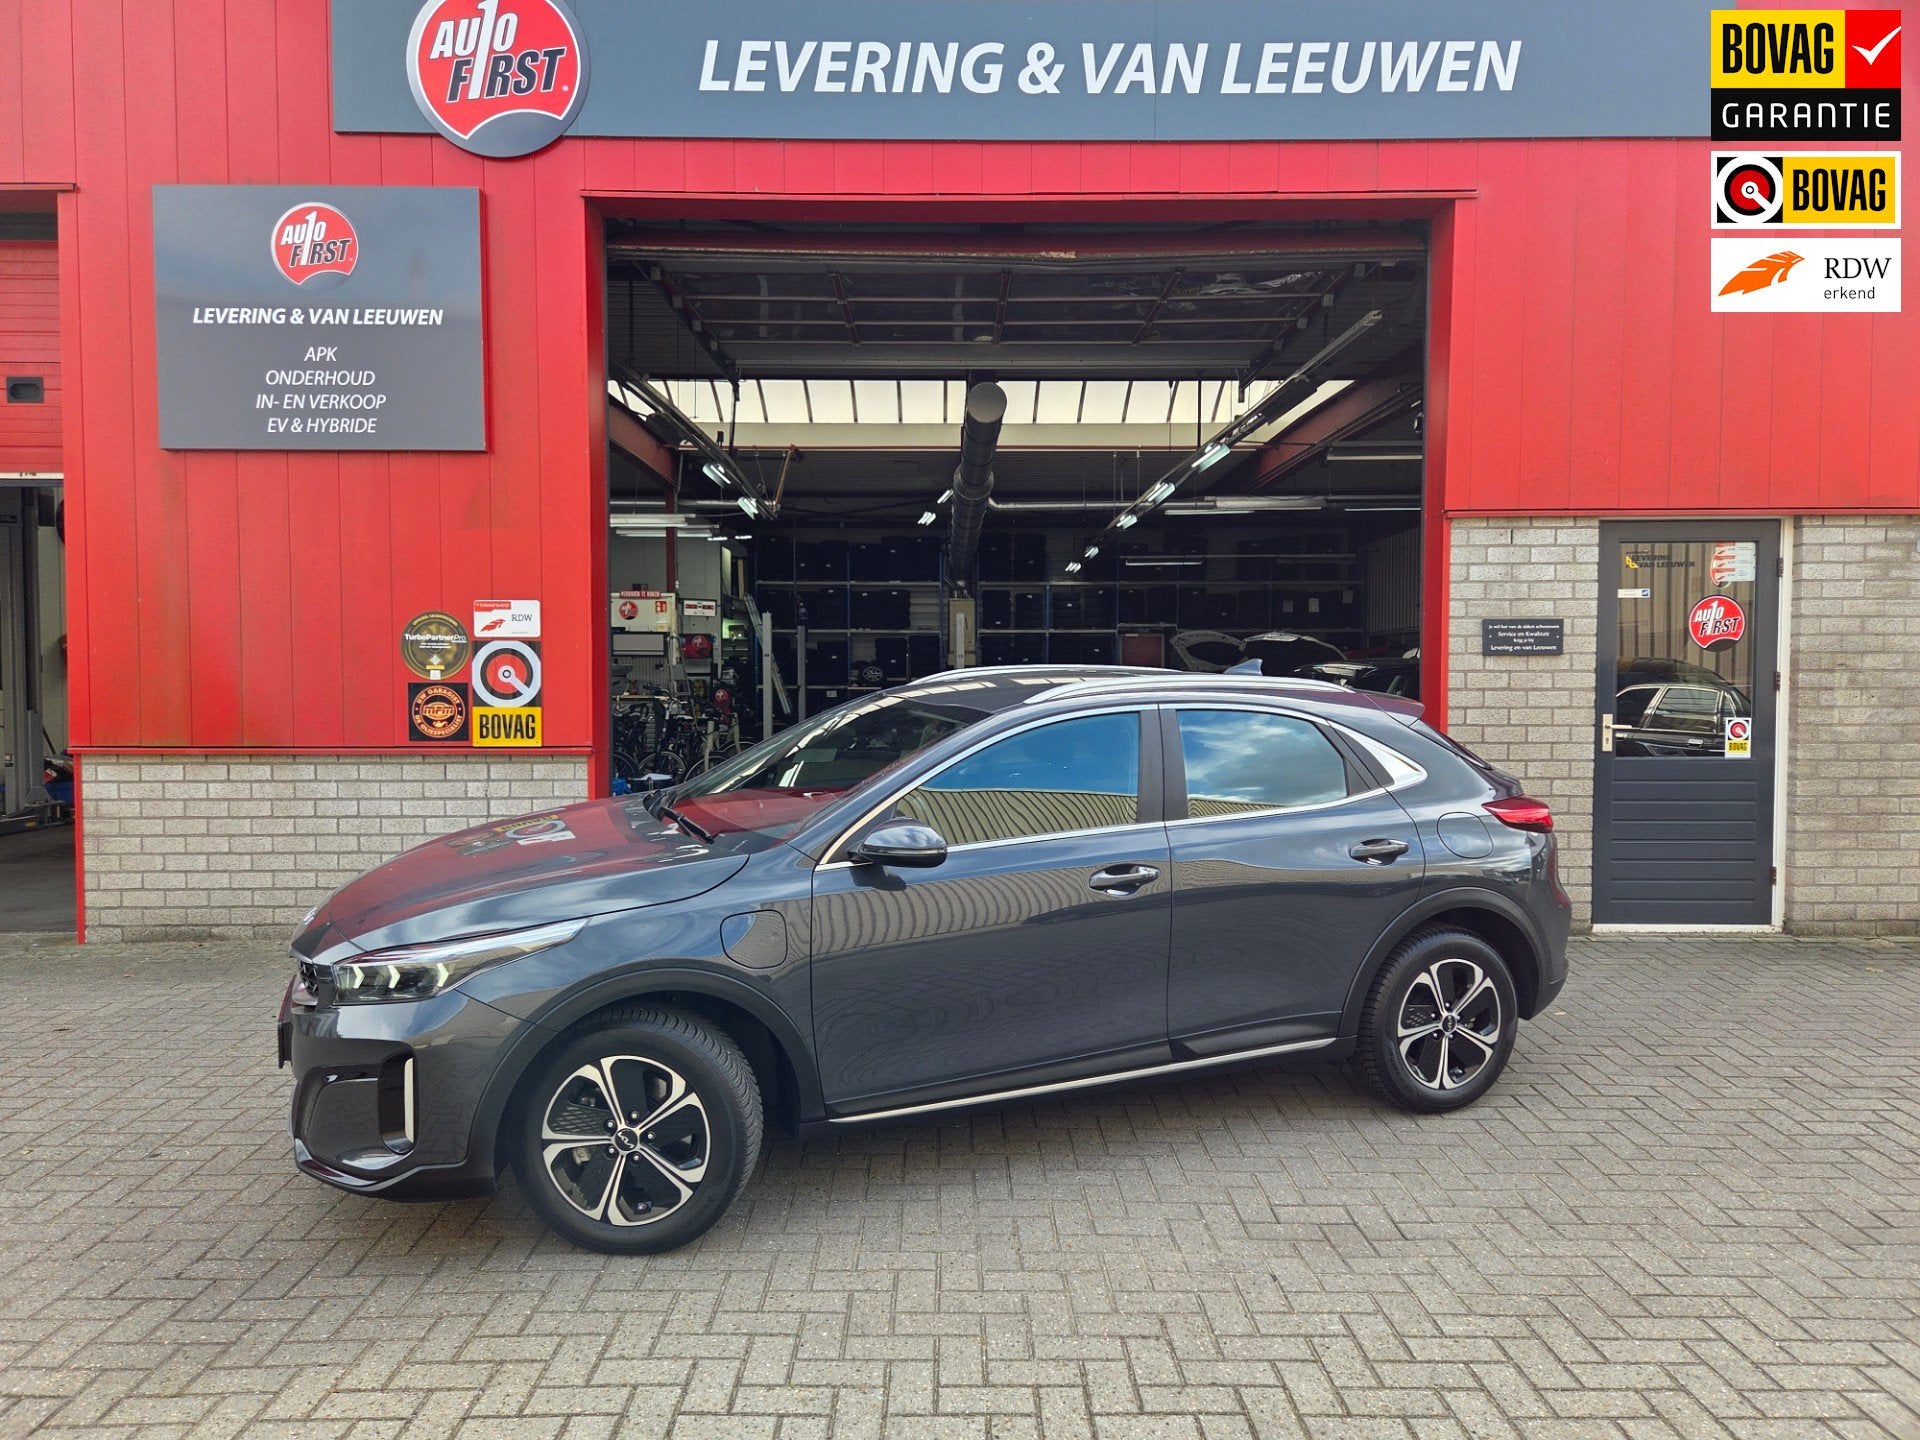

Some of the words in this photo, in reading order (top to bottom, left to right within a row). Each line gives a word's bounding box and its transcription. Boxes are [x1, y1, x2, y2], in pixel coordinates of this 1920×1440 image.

[699, 39, 1005, 94] LEVERING
[1017, 41, 1066, 95] &
[1081, 42, 1209, 94] VAN
[1220, 40, 1522, 94] LEEUWEN
[193, 307, 286, 325] LEVERING
[289, 308, 305, 325] &
[308, 308, 350, 325] VAN
[352, 309, 443, 326] LEEUWEN
[304, 346, 338, 362] APK
[265, 370, 376, 386] ONDERHOUD
[255, 394, 280, 410] IN-
[283, 394, 305, 410] EN
[309, 394, 387, 410] VERKOOP
[267, 418, 289, 433] EV
[290, 418, 304, 433] &
[306, 418, 378, 433] HYBRIDE
[511, 613, 533, 622] RDW
[479, 713, 536, 740] BOVAG
